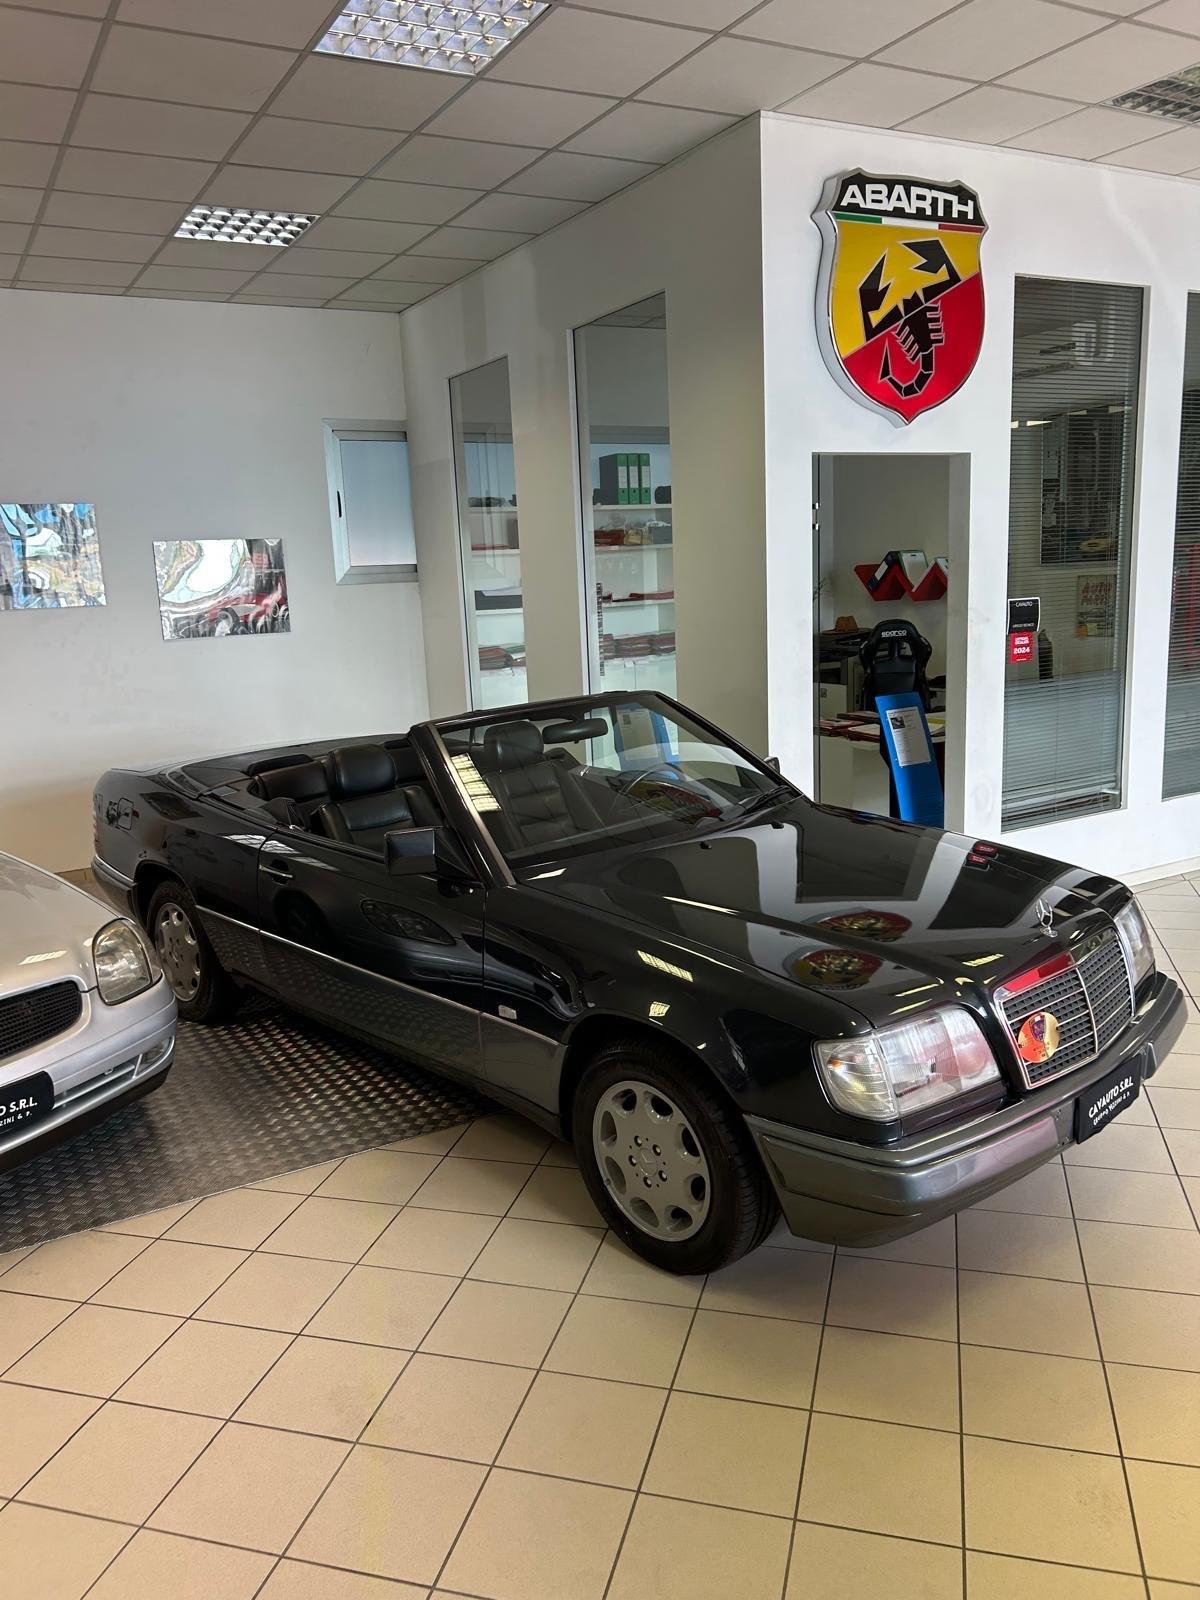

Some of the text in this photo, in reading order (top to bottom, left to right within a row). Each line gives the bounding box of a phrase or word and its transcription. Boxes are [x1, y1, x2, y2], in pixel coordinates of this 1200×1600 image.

[840, 183, 974, 220] ABARTH
[1013, 646, 1031, 655] 2024
[9, 1096, 38, 1113] S.R.L.
[1088, 1085, 1119, 1119] CAVAUTO
